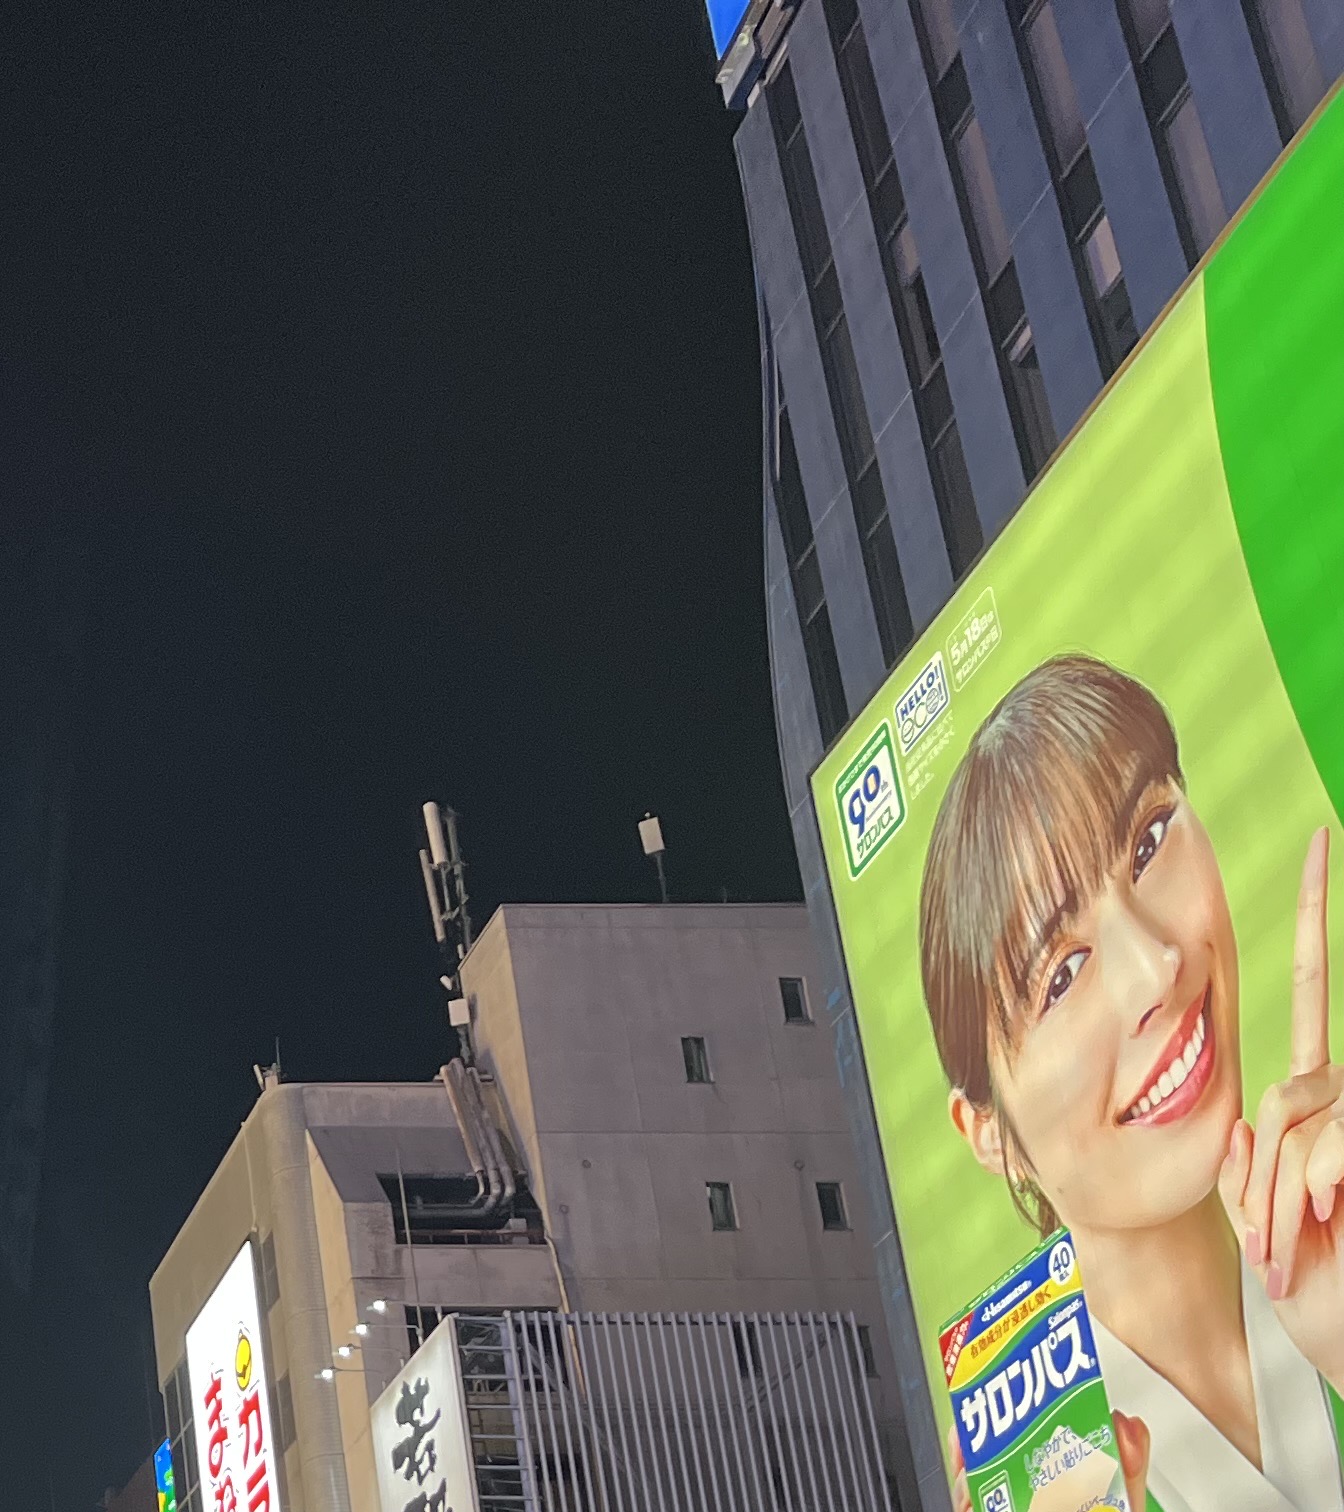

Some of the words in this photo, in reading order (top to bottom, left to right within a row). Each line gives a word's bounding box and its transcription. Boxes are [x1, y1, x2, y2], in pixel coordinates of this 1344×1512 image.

[899, 663, 941, 720] HELLO!
[857, 806, 895, 858] サロンパス
[1053, 1246, 1070, 1274] 40
[961, 1316, 1091, 1454] サロンパス
